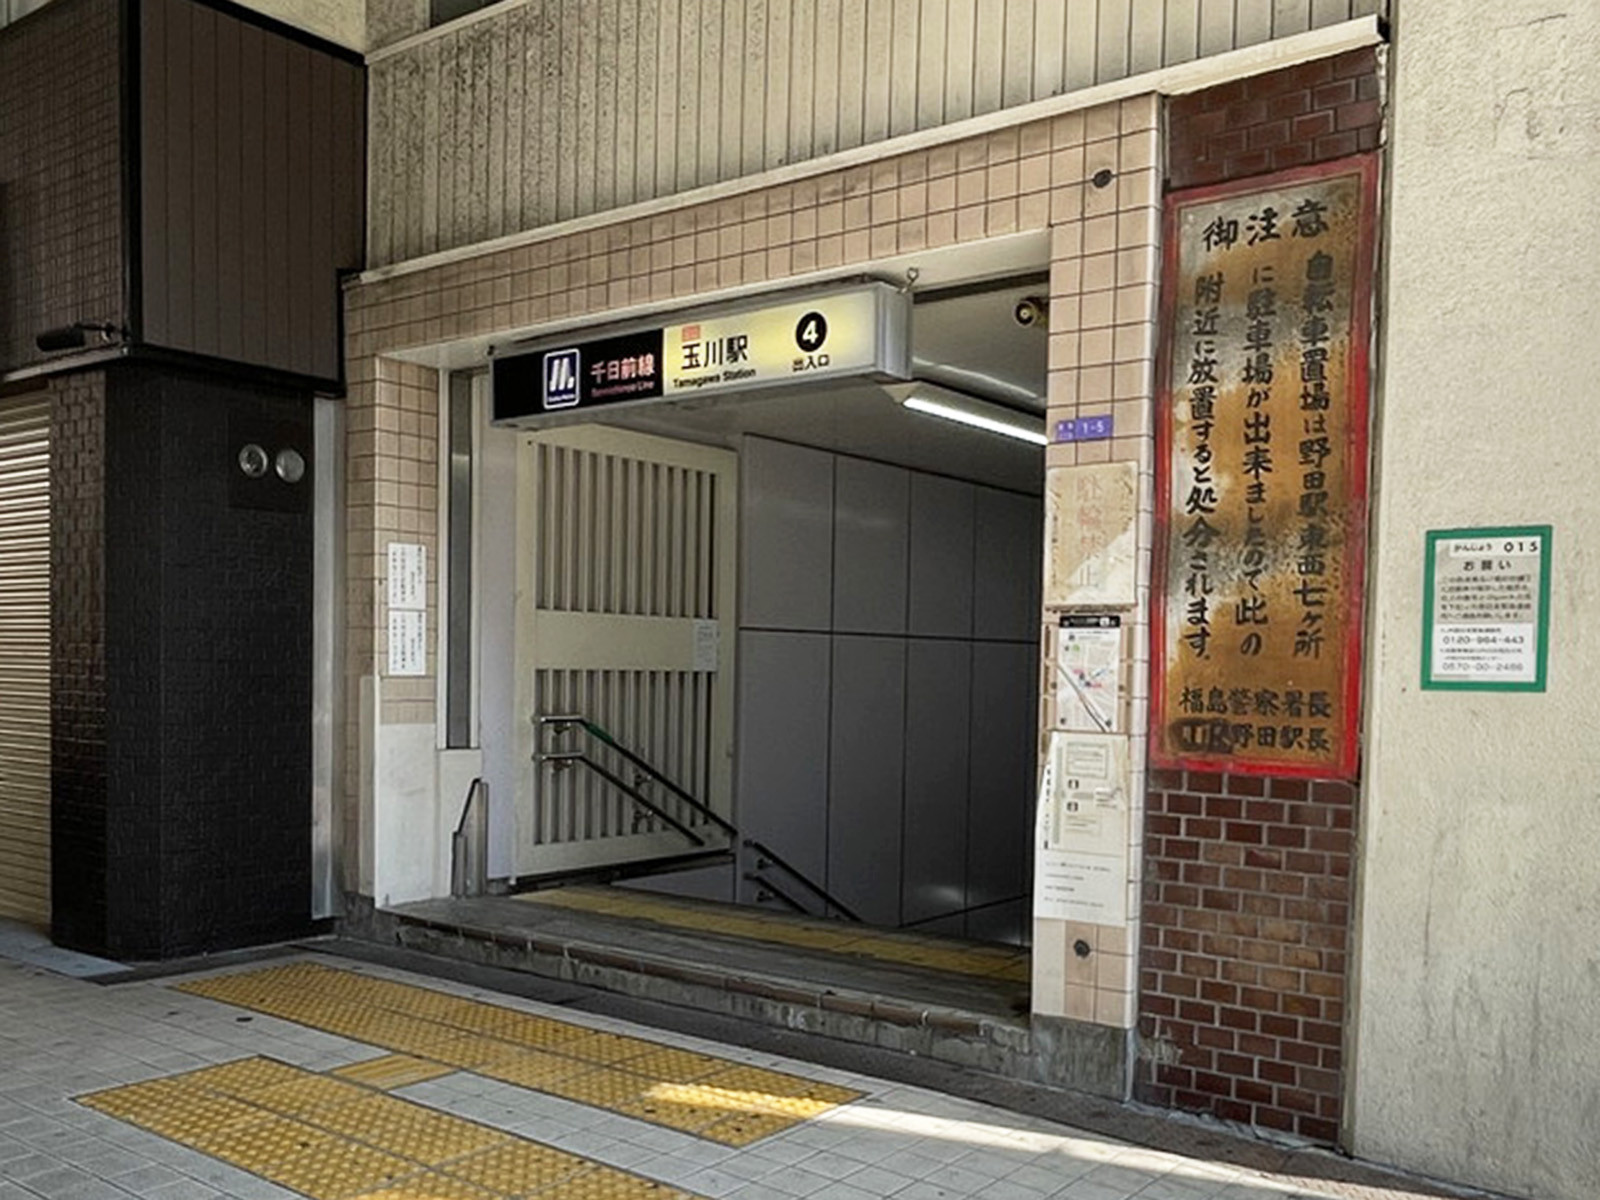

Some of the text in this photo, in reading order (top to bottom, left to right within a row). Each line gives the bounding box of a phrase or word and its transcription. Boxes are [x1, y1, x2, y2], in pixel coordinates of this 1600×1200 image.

[1202, 197, 1330, 252] 御注意
[681, 334, 748, 371] 玉川駅
[792, 354, 830, 373] 出入口
[590, 352, 655, 384] 千日前線
[672, 367, 757, 388] Tamagawa Station
[1503, 540, 1539, 553] 015
[1462, 559, 1512, 572] お願い
[1178, 685, 1332, 718] 福島警察署長
